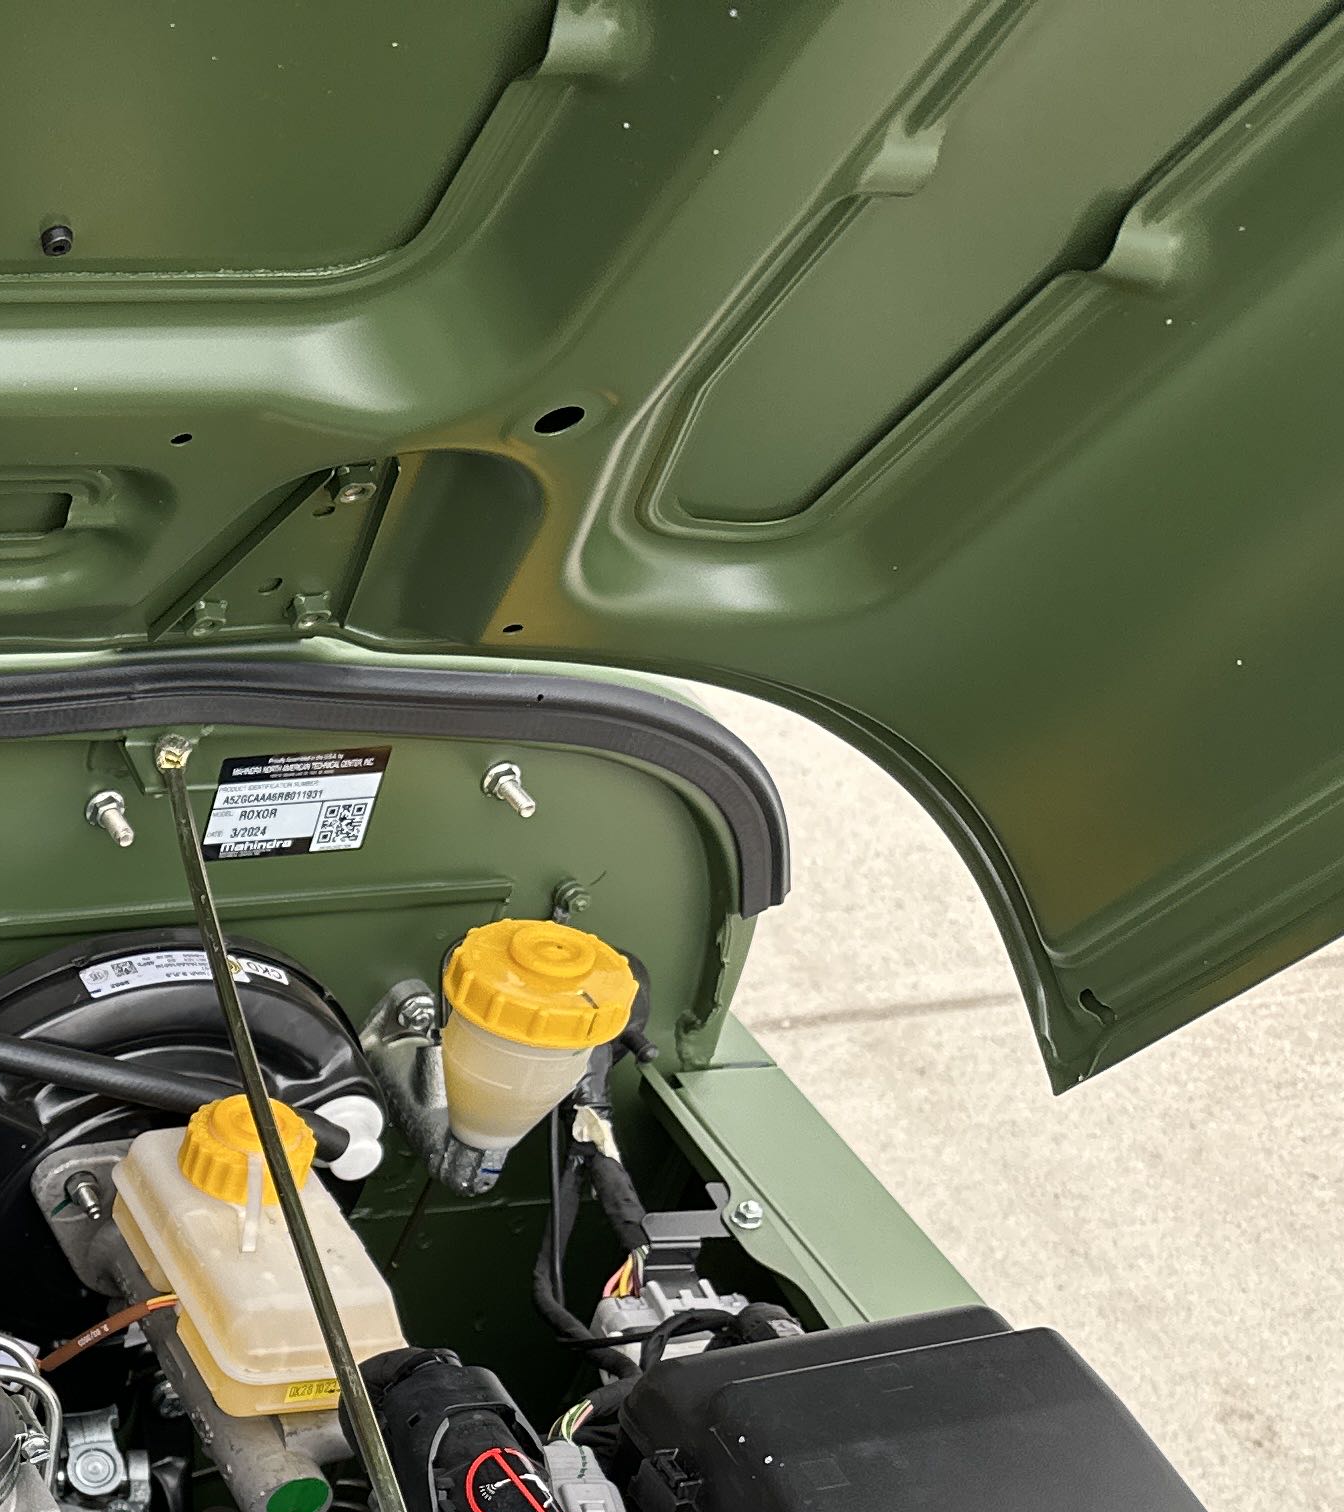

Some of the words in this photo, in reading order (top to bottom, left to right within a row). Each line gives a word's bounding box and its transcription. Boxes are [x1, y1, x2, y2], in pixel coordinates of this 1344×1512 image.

[239, 808, 278, 821] ROXOR
[230, 826, 267, 838] 3/2024
[220, 839, 293, 852] Mahindra
